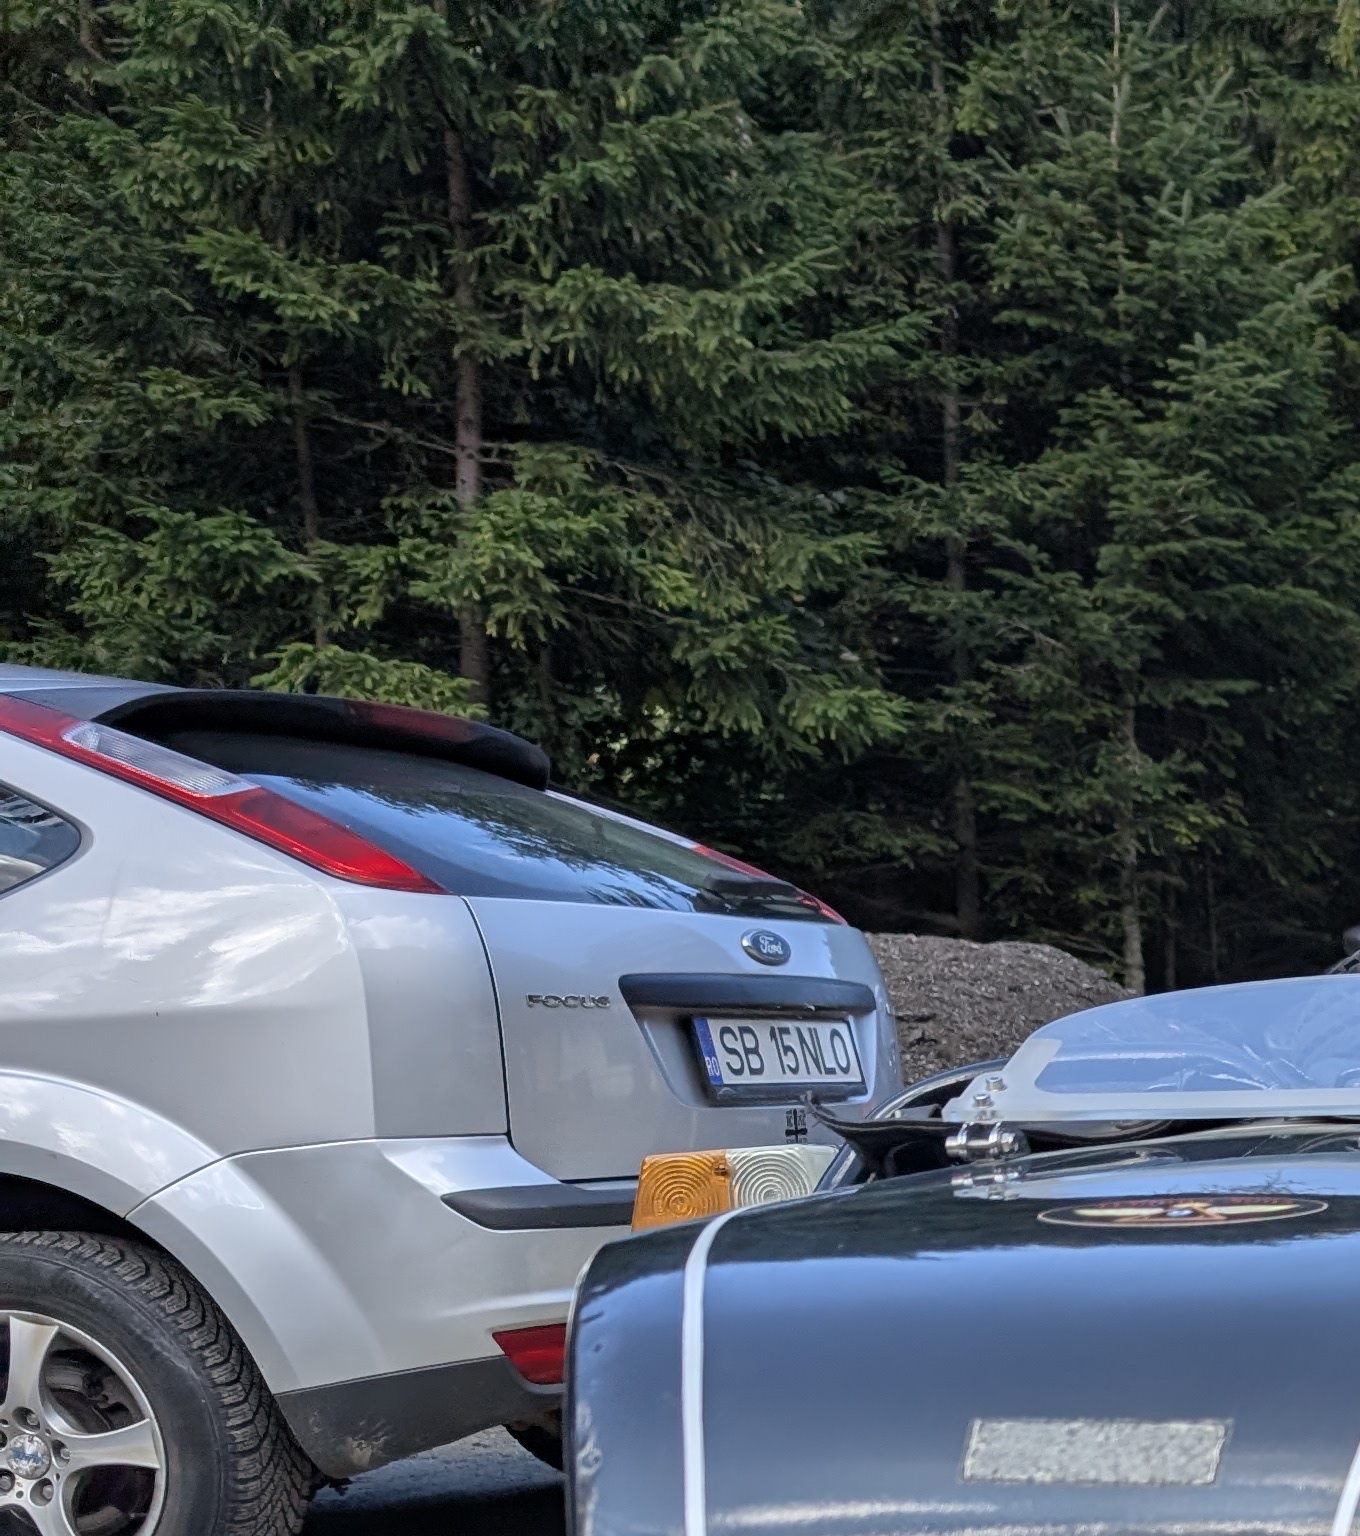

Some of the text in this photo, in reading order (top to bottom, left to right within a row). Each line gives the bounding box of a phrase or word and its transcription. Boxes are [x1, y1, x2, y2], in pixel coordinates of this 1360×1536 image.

[526, 993, 611, 1009] FOCUS
[719, 1025, 851, 1076] SB 15 NLO
